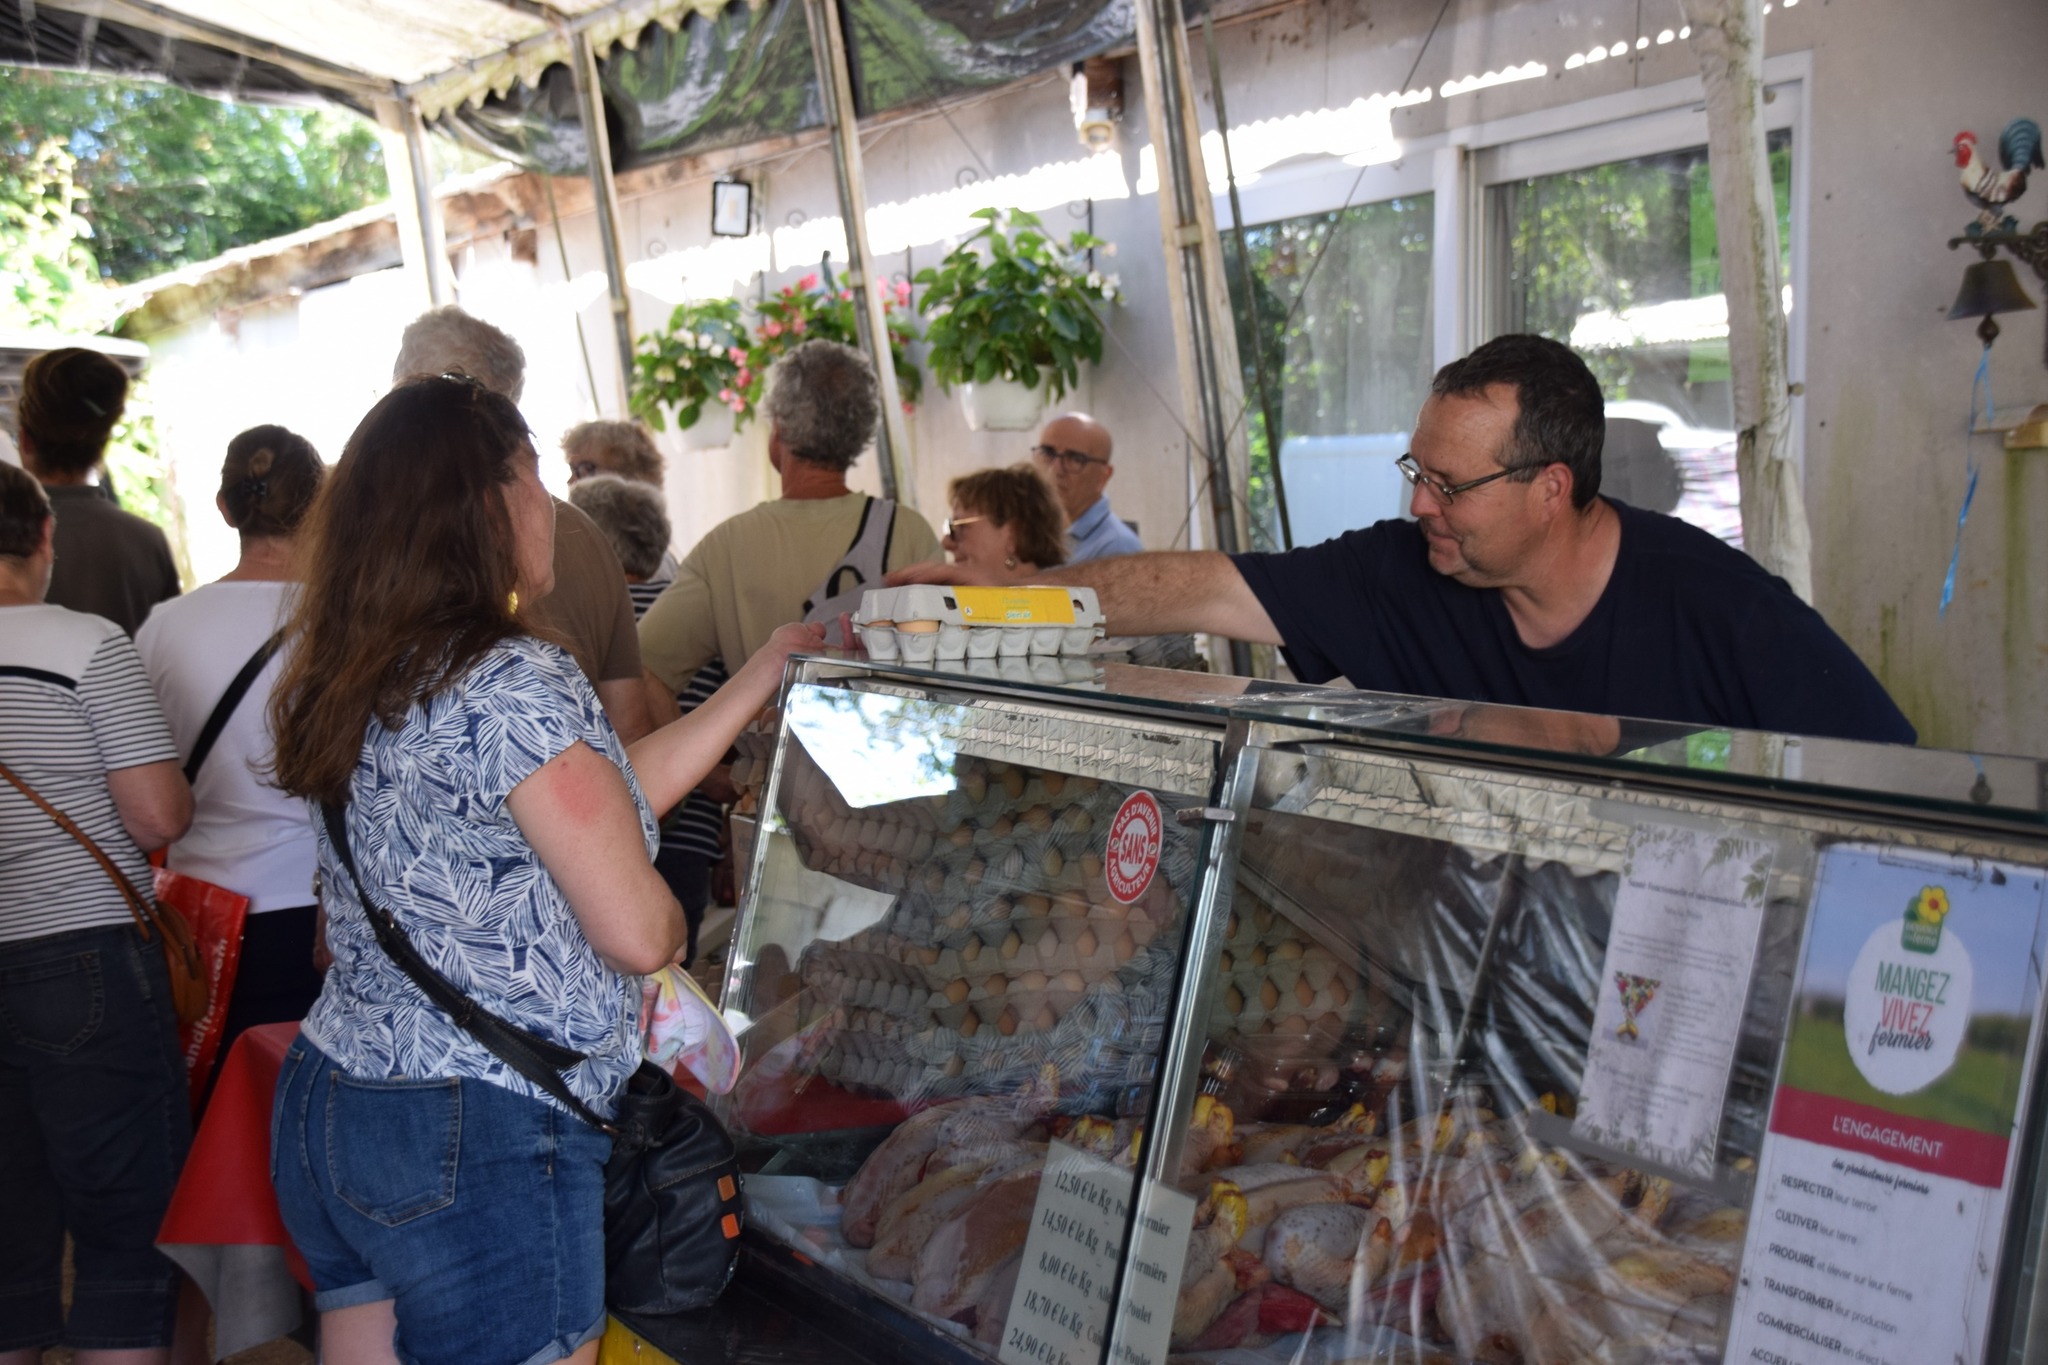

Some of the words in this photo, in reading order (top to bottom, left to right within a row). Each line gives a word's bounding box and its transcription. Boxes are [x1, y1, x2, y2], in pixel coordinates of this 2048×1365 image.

[1116, 809, 1130, 834] PAS
[1131, 802, 1158, 838] D'AVENIR
[1120, 832, 1147, 865] SANS
[1110, 858, 1152, 894] AGRICULTEUR
[1874, 960, 1950, 1004] MANGEZ
[1882, 996, 1934, 1036] VIVEZ
[1868, 1022, 1934, 1056] fermier
[1832, 1115, 1944, 1159] L'ENGAGEMENT
[1054, 1170, 1082, 1196] 12,50
[1081, 1180, 1090, 1200] €
[1088, 1183, 1098, 1204] le
[1098, 1188, 1112, 1215] Kg
[1780, 1174, 1834, 1200] RESPECTER
[1834, 1192, 1849, 1205] leur
[1852, 1197, 1878, 1213] terroir
[1844, 1163, 1894, 1185] producteurs
[1894, 1175, 1930, 1196] fermiers
[1042, 1208, 1068, 1234] 14,50
[1068, 1218, 1077, 1238] €
[1074, 1222, 1085, 1243] le
[1085, 1227, 1099, 1254] Kg
[1775, 1208, 1818, 1232] CULTIVER
[1819, 1224, 1834, 1237] leur
[1836, 1230, 1857, 1245] terre
[1039, 1251, 1060, 1276] 8,00
[1060, 1261, 1070, 1282] €
[1068, 1264, 1078, 1285] le
[1078, 1270, 1092, 1298] Kg
[1126, 1300, 1152, 1325] Poulet
[1768, 1242, 1816, 1268] PRODUIRE
[1854, 1273, 1867, 1286] sur
[1868, 1275, 1884, 1290] leur
[1886, 1281, 1912, 1301] ferme
[1024, 1288, 1051, 1318] 18,70
[1050, 1302, 1060, 1322] €
[1058, 1306, 1068, 1328] le
[1069, 1312, 1084, 1340] Kg
[1764, 1277, 1834, 1312] TRANSFORMER
[1834, 1304, 1850, 1318] leur
[1851, 1310, 1898, 1334] production
[1008, 1327, 1038, 1356] 24,90
[1038, 1340, 1048, 1361] €
[1046, 1344, 1056, 1365] le
[1756, 1312, 1842, 1352] COMMERCIALISER
[1855, 1349, 1880, 1365] direct
